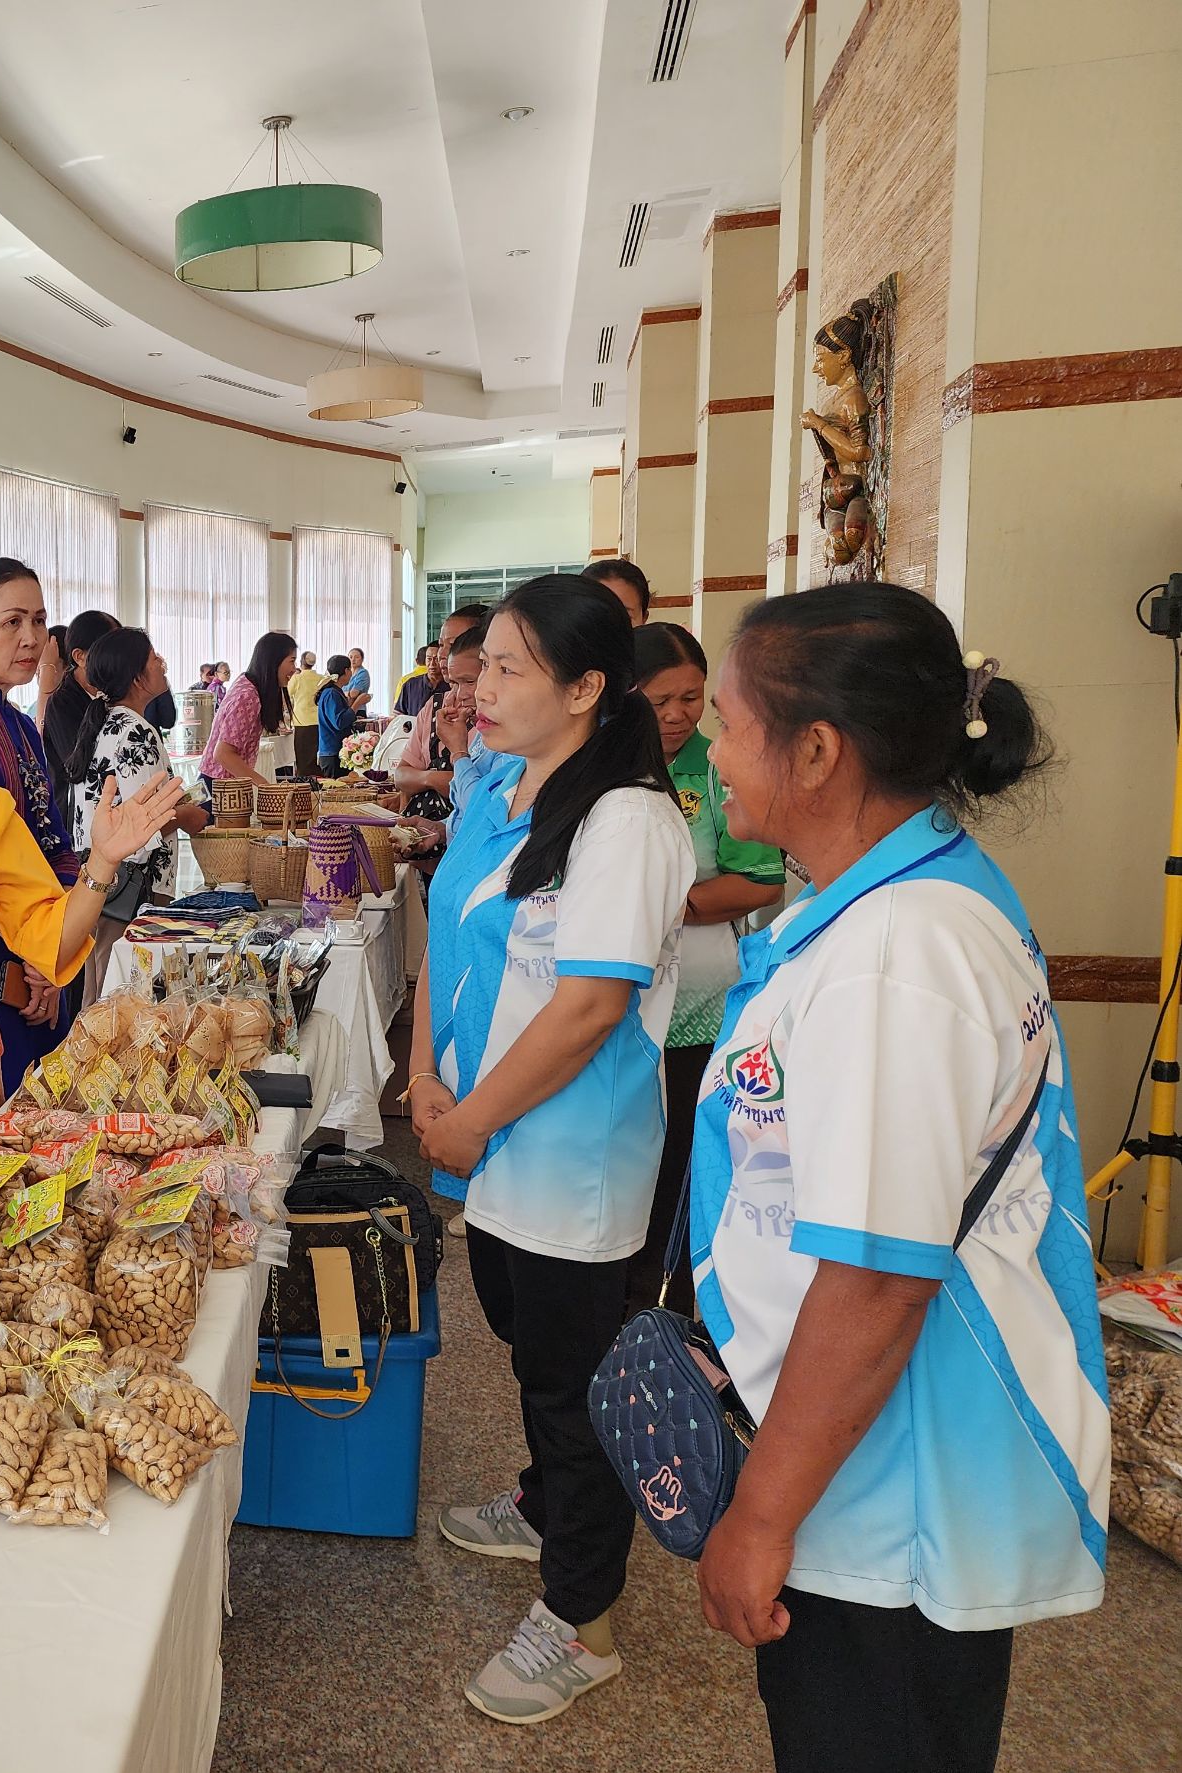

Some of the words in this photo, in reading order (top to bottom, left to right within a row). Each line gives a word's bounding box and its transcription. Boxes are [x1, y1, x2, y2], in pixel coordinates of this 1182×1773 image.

[713, 1067, 786, 1130] วิสาหกิจชุมช
